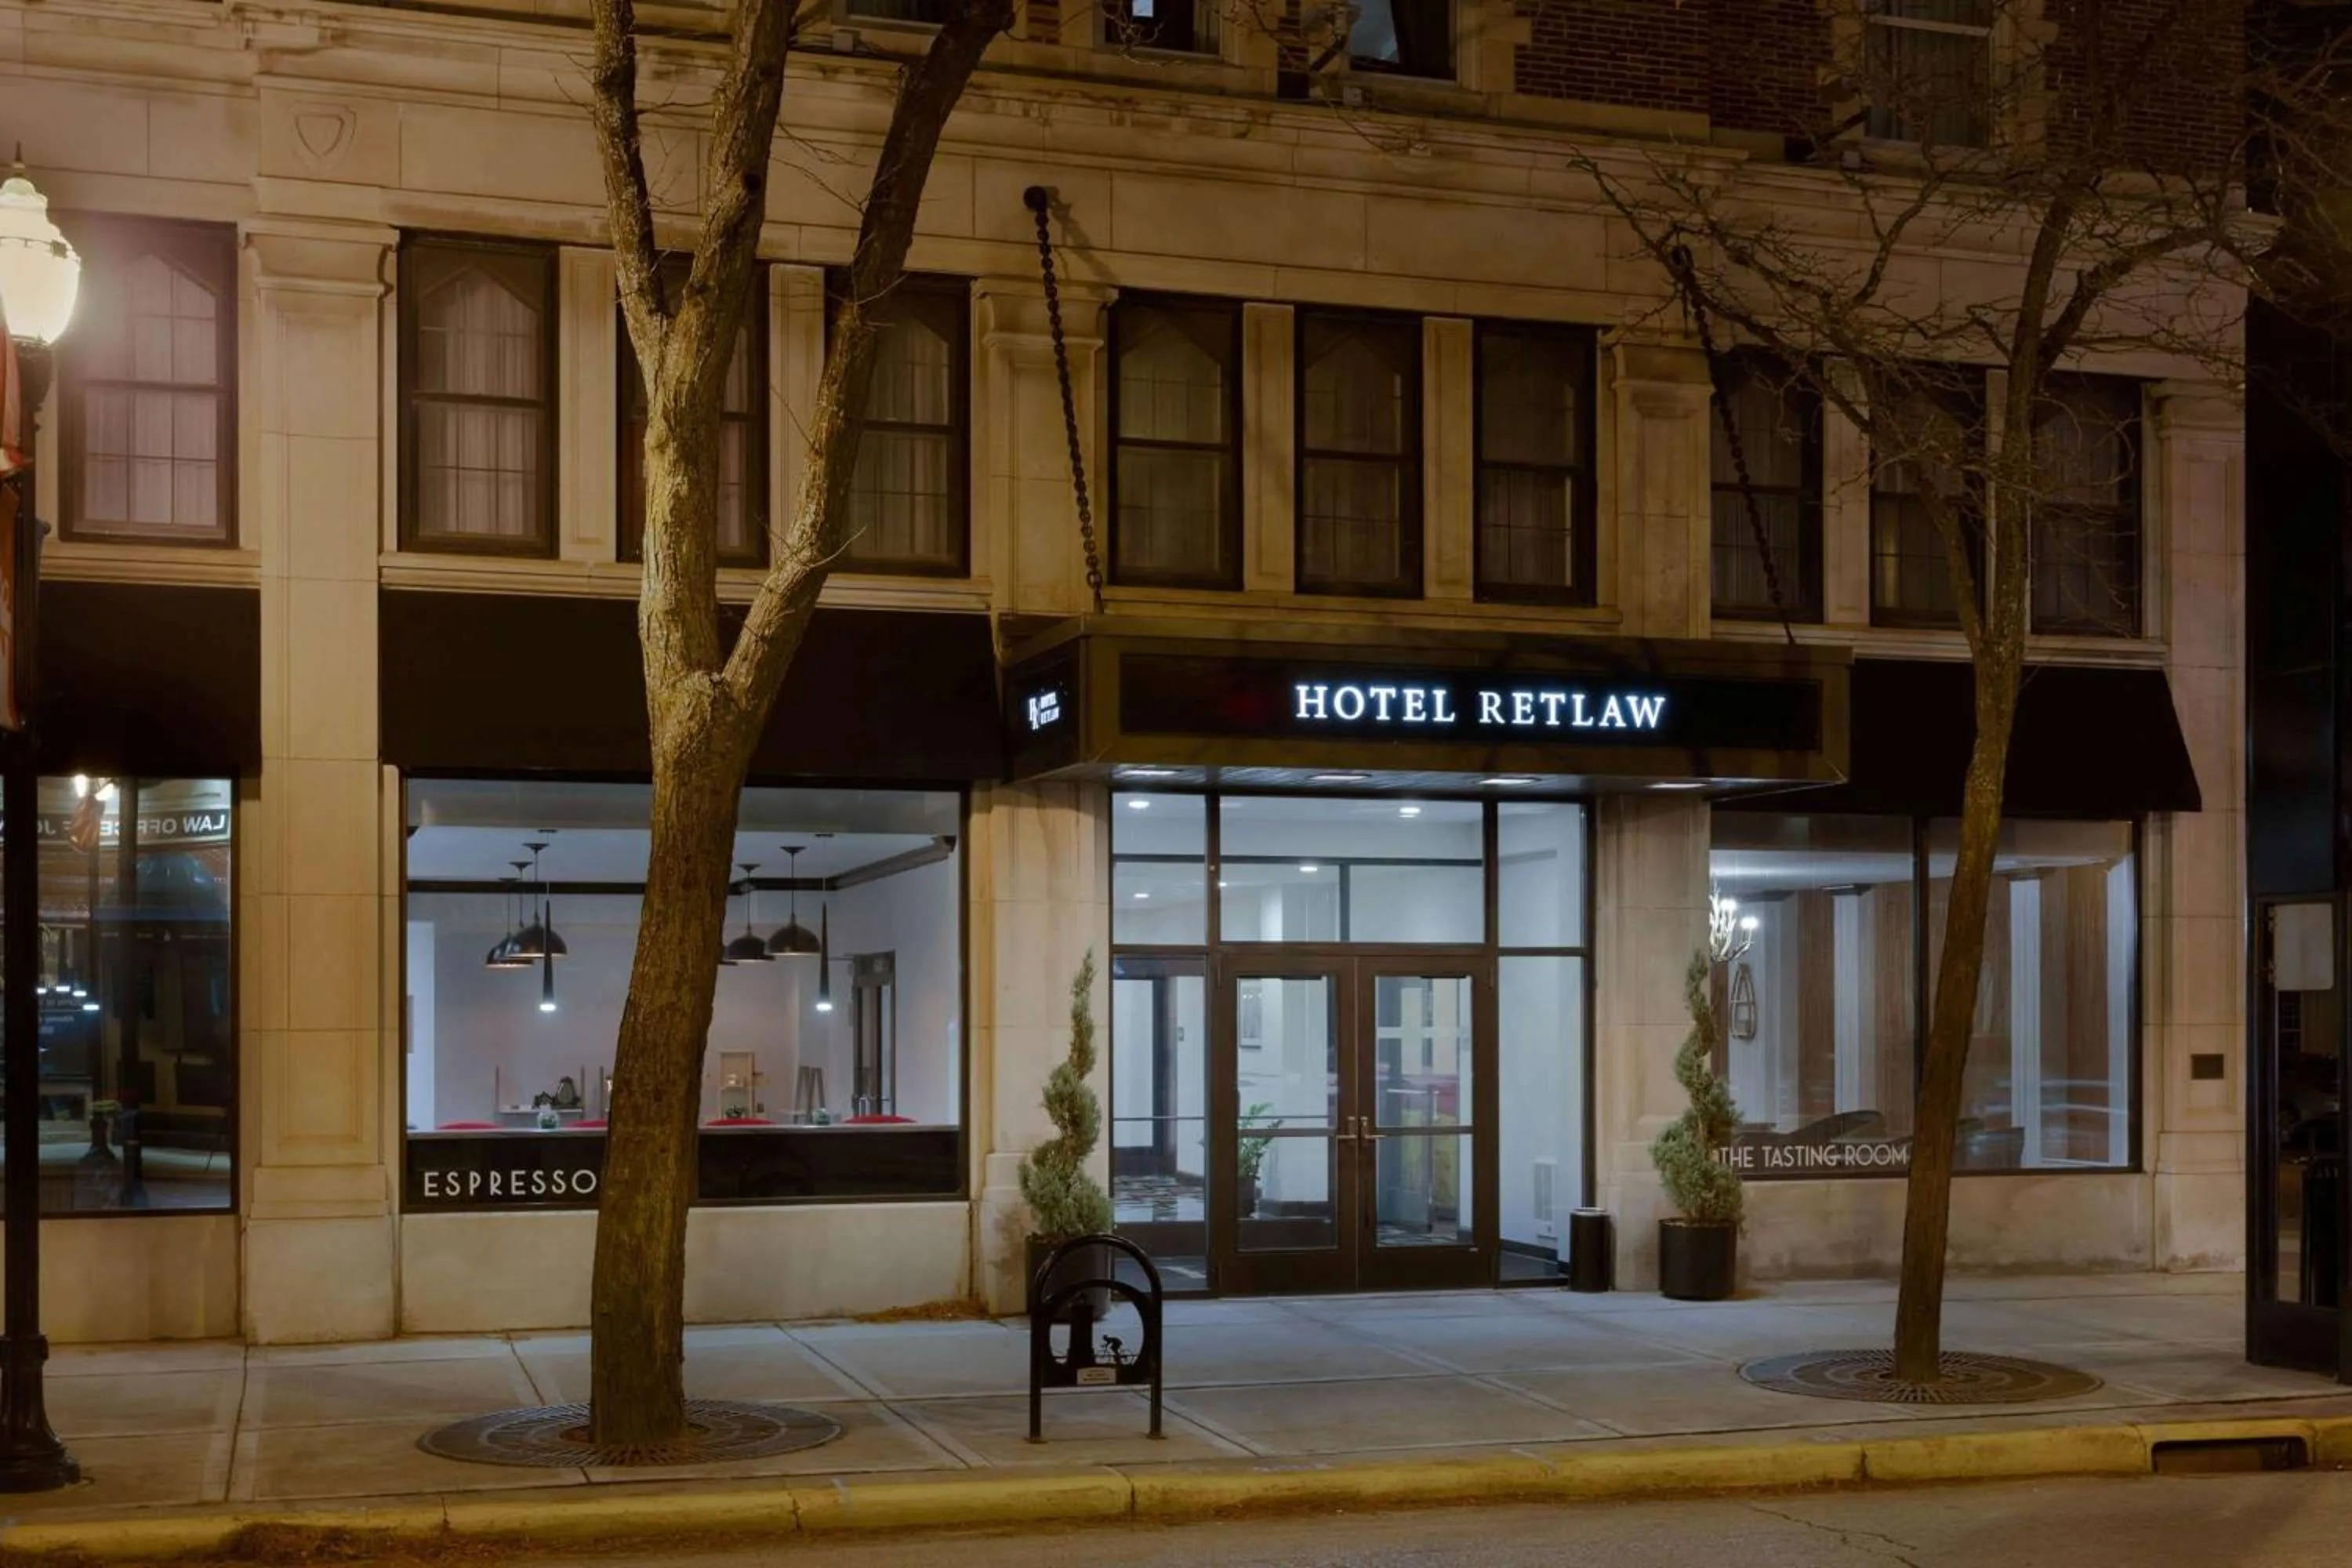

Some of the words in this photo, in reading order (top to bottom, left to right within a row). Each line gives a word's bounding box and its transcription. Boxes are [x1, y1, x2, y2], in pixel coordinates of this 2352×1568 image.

[1295, 684, 1455, 722] HOTEL
[1479, 691, 1665, 728] RETLAW
[1719, 1145, 1755, 1168] THE
[1762, 1145, 1838, 1167] TASTING
[1845, 1143, 1907, 1166] ROOM
[424, 1169, 597, 1197] ESPRESSO
